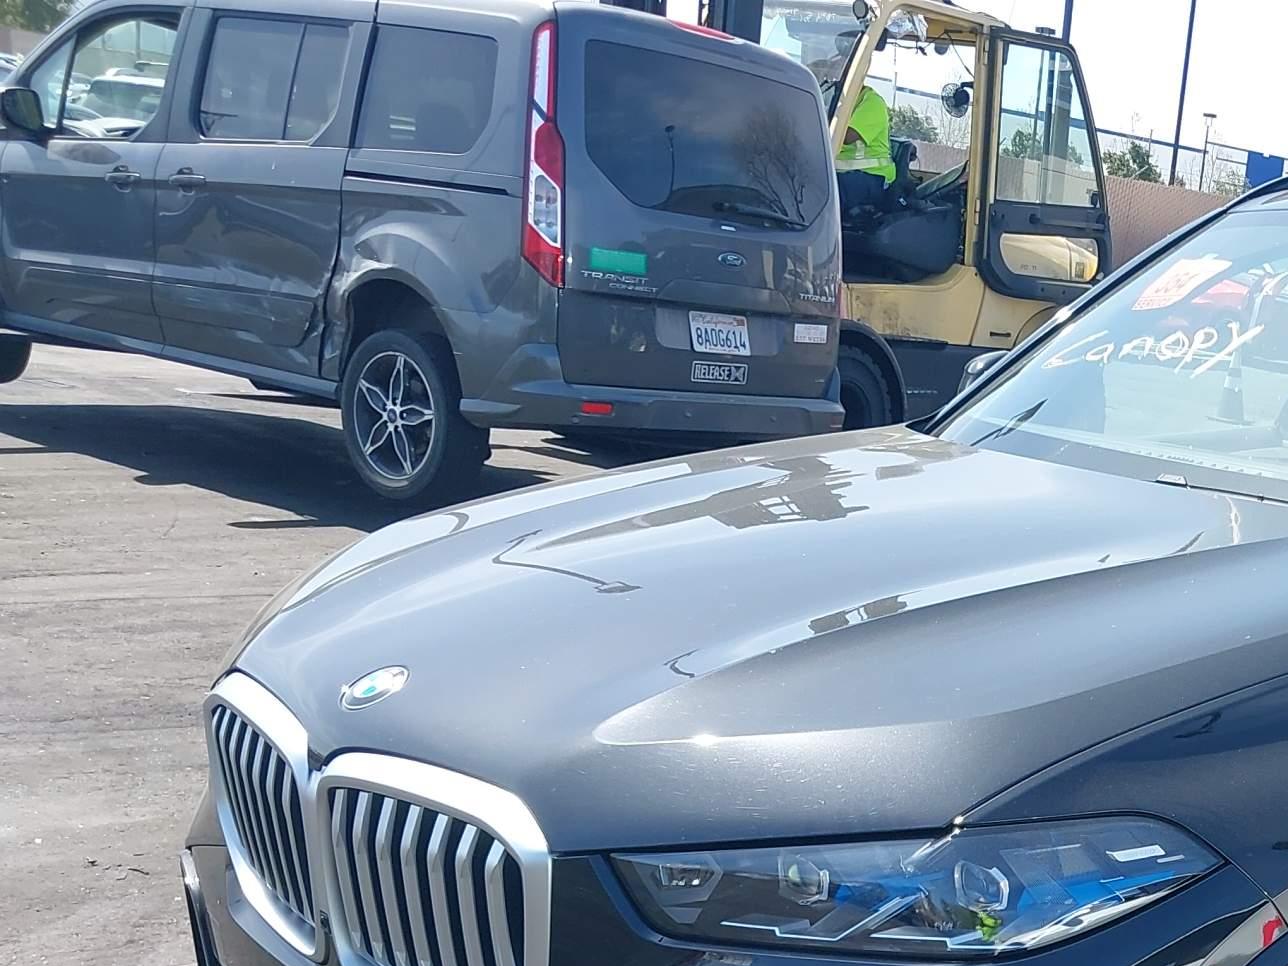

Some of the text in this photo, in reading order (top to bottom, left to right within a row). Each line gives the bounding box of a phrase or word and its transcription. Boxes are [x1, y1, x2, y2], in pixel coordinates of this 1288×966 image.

[580, 269, 649, 286] TRANSIT
[608, 282, 659, 294] CONNECT
[694, 363, 730, 380] RELEASE
